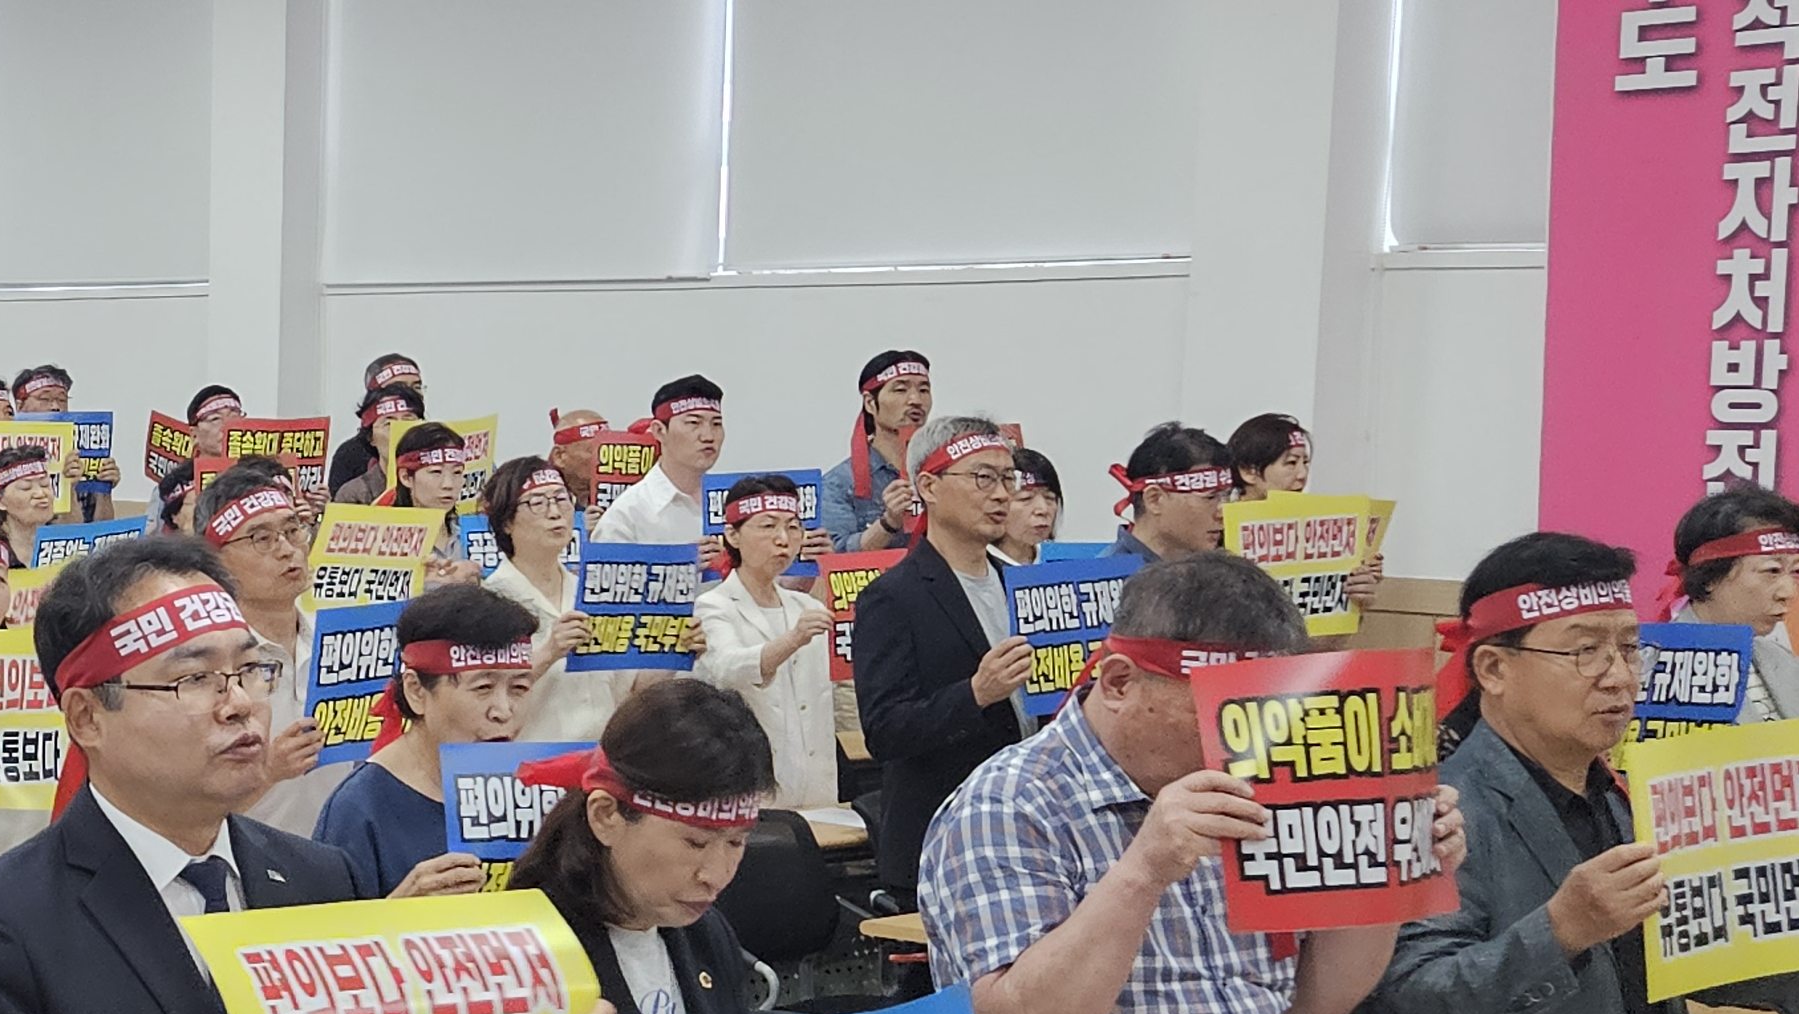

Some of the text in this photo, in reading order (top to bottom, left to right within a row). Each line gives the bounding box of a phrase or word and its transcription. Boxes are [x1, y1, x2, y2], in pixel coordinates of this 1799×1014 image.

[109, 606, 179, 658] 국민
[1015, 581, 1080, 636] 편의위한
[318, 627, 398, 687] 편의위한
[1653, 650, 1741, 706] 규제완화
[1220, 692, 1383, 780] 의약품이
[1723, 758, 1799, 841] 안전먼
[1240, 802, 1390, 891] 국민안전
[1732, 856, 1799, 940] 국민먼
